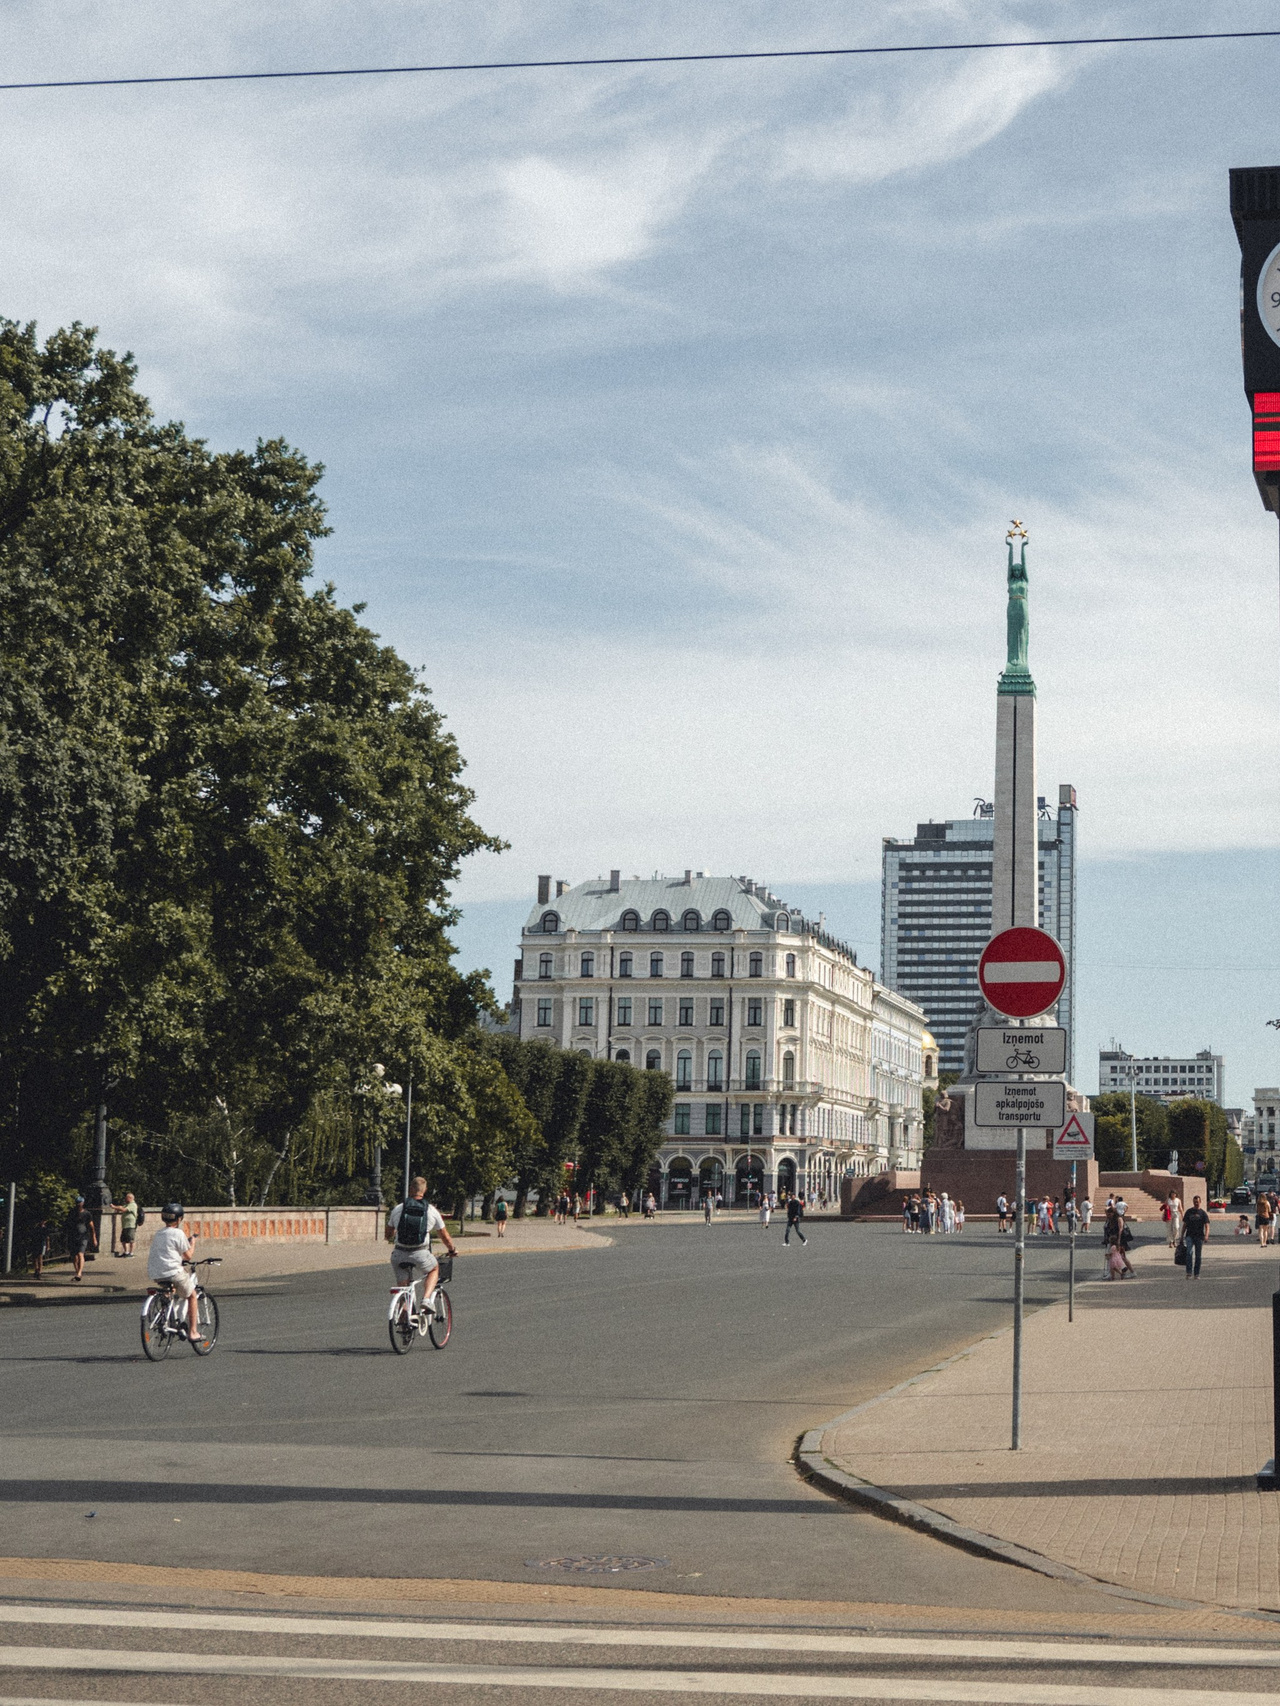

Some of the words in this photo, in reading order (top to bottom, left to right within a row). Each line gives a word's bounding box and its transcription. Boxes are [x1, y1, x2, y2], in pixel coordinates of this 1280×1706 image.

[1003, 1032, 1044, 1046] Izņemot
[1004, 1086, 1037, 1098] Izņemot
[995, 1098, 1045, 1110] apkalpojošo
[998, 1111, 1041, 1123] transportu
